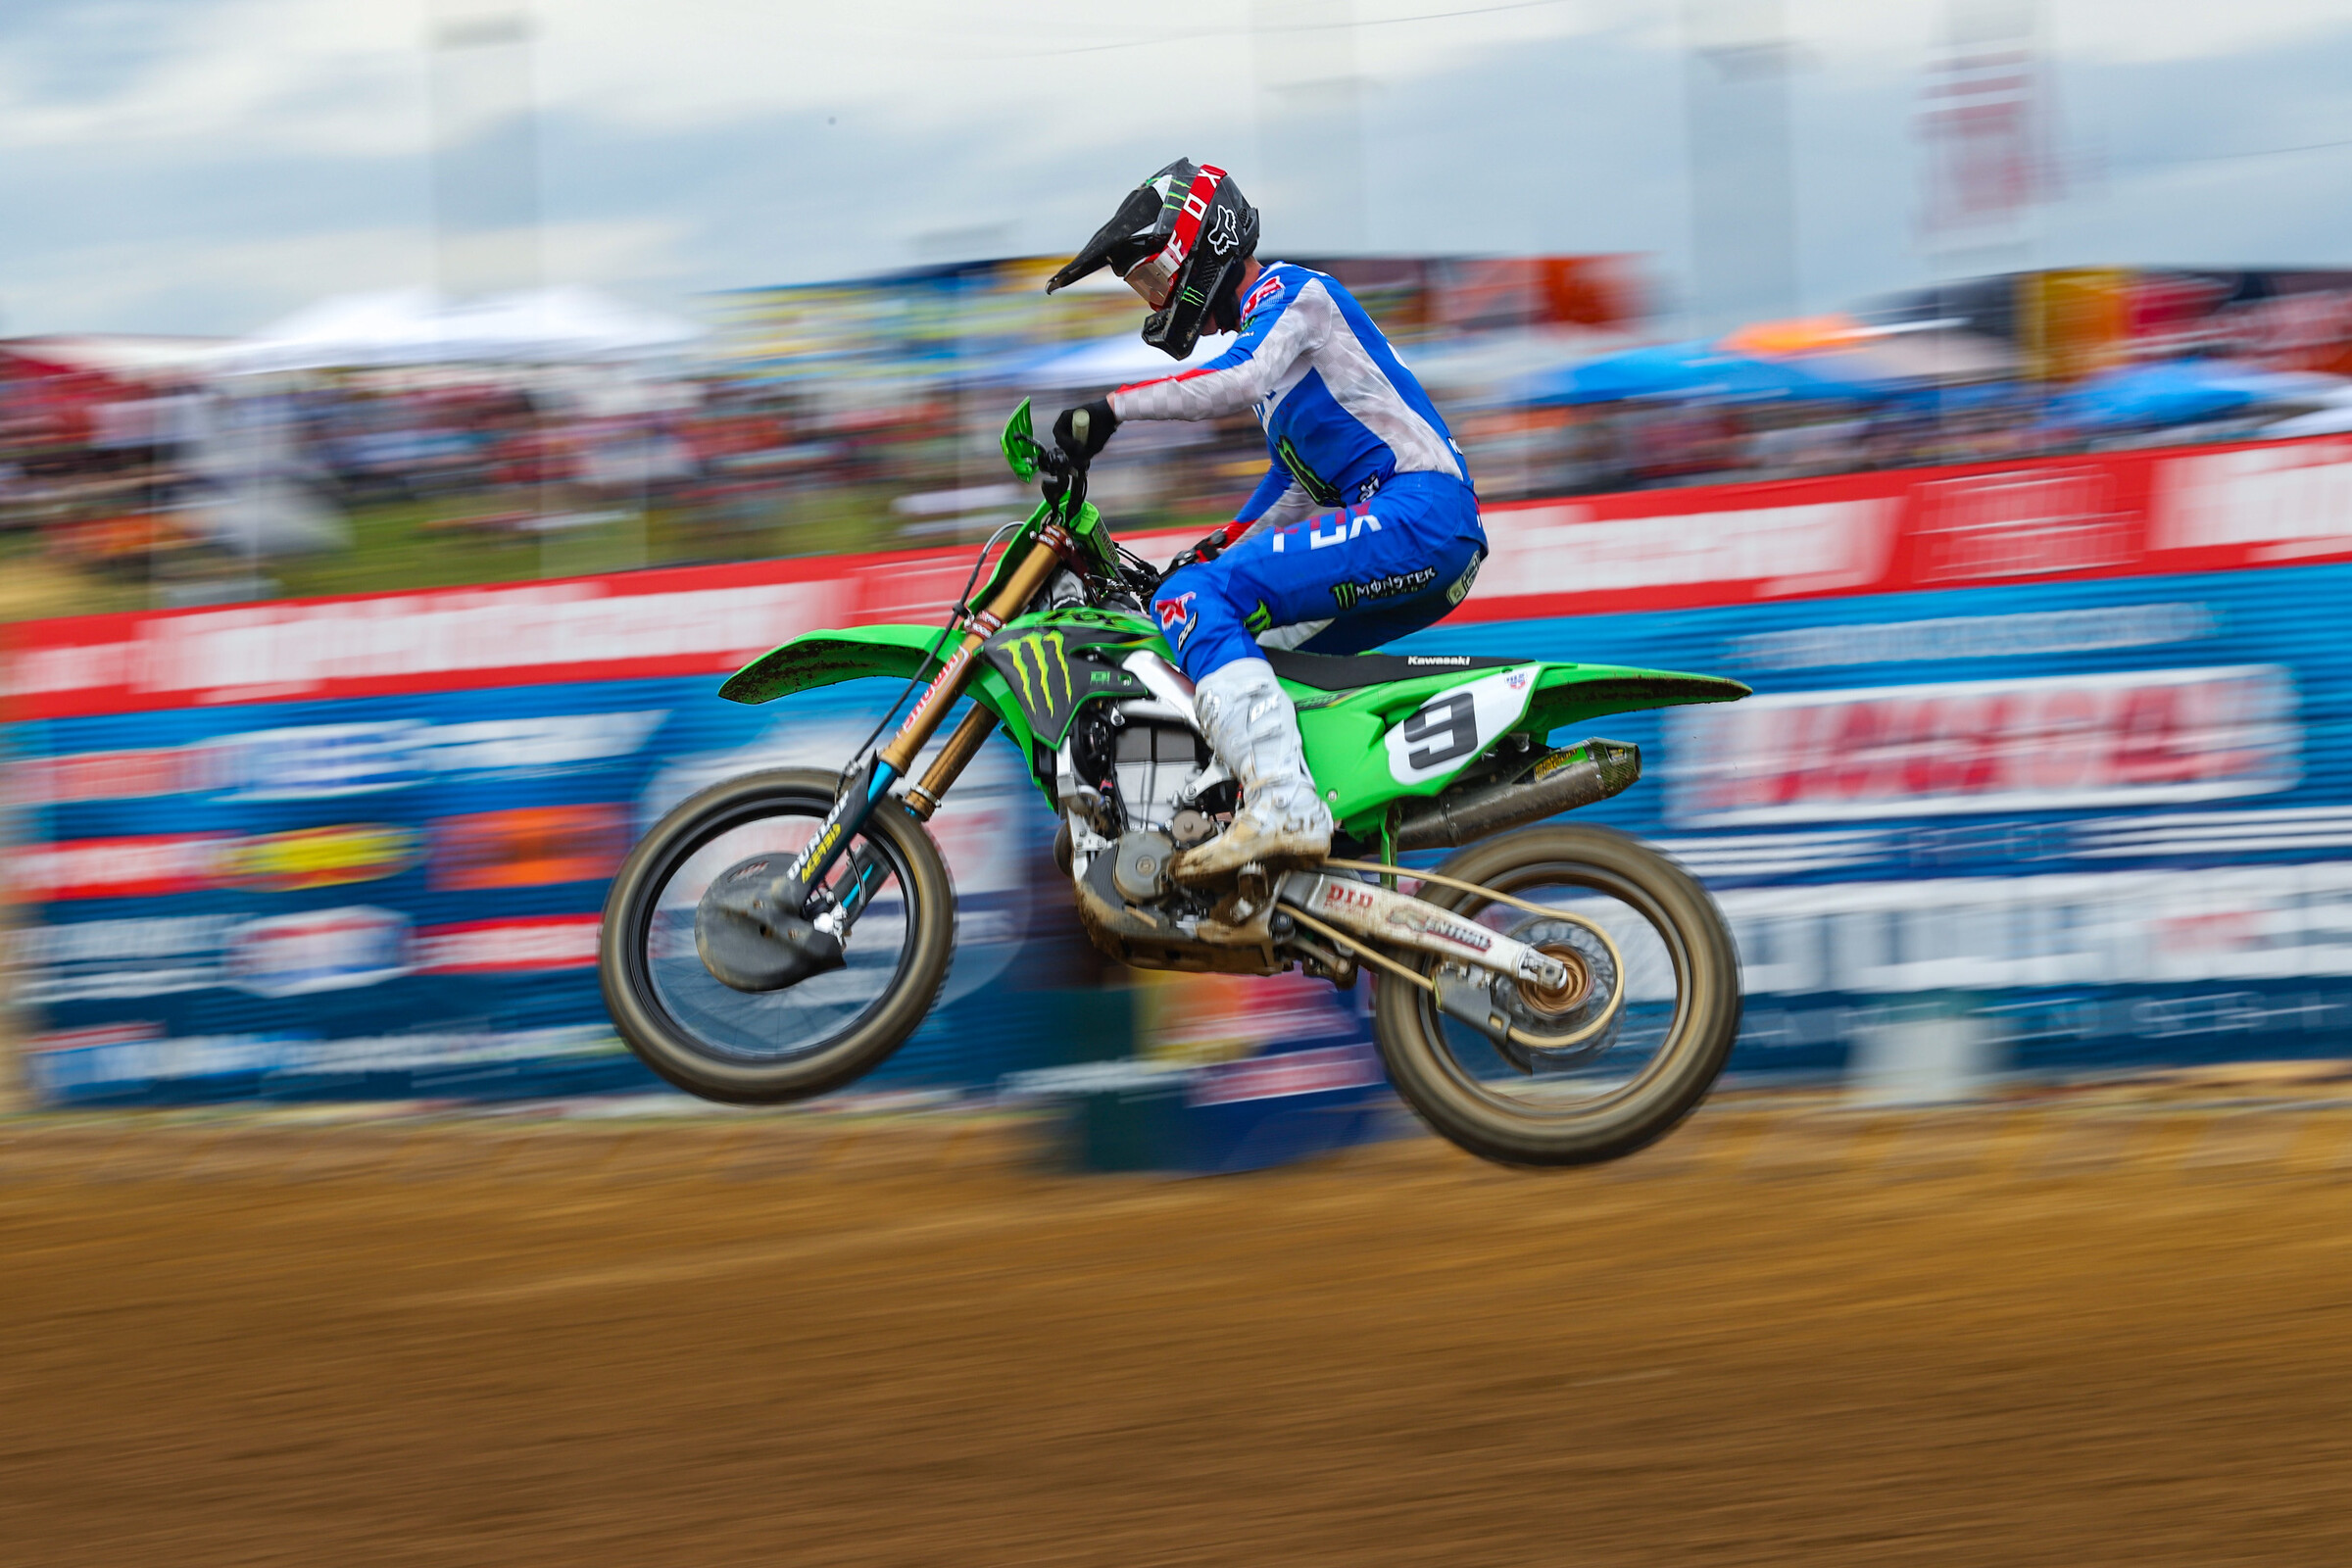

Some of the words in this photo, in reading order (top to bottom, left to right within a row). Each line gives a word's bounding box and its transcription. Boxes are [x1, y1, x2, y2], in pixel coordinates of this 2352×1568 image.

[1167, 168, 1221, 263] FOX
[1272, 500, 1383, 554] FOX
[1356, 566, 1437, 597] MONSTER
[1407, 656, 1470, 666] Kawasaki
[1403, 691, 1479, 770] 9
[786, 789, 851, 881] DUNLOP
[1326, 884, 1374, 909] DID
